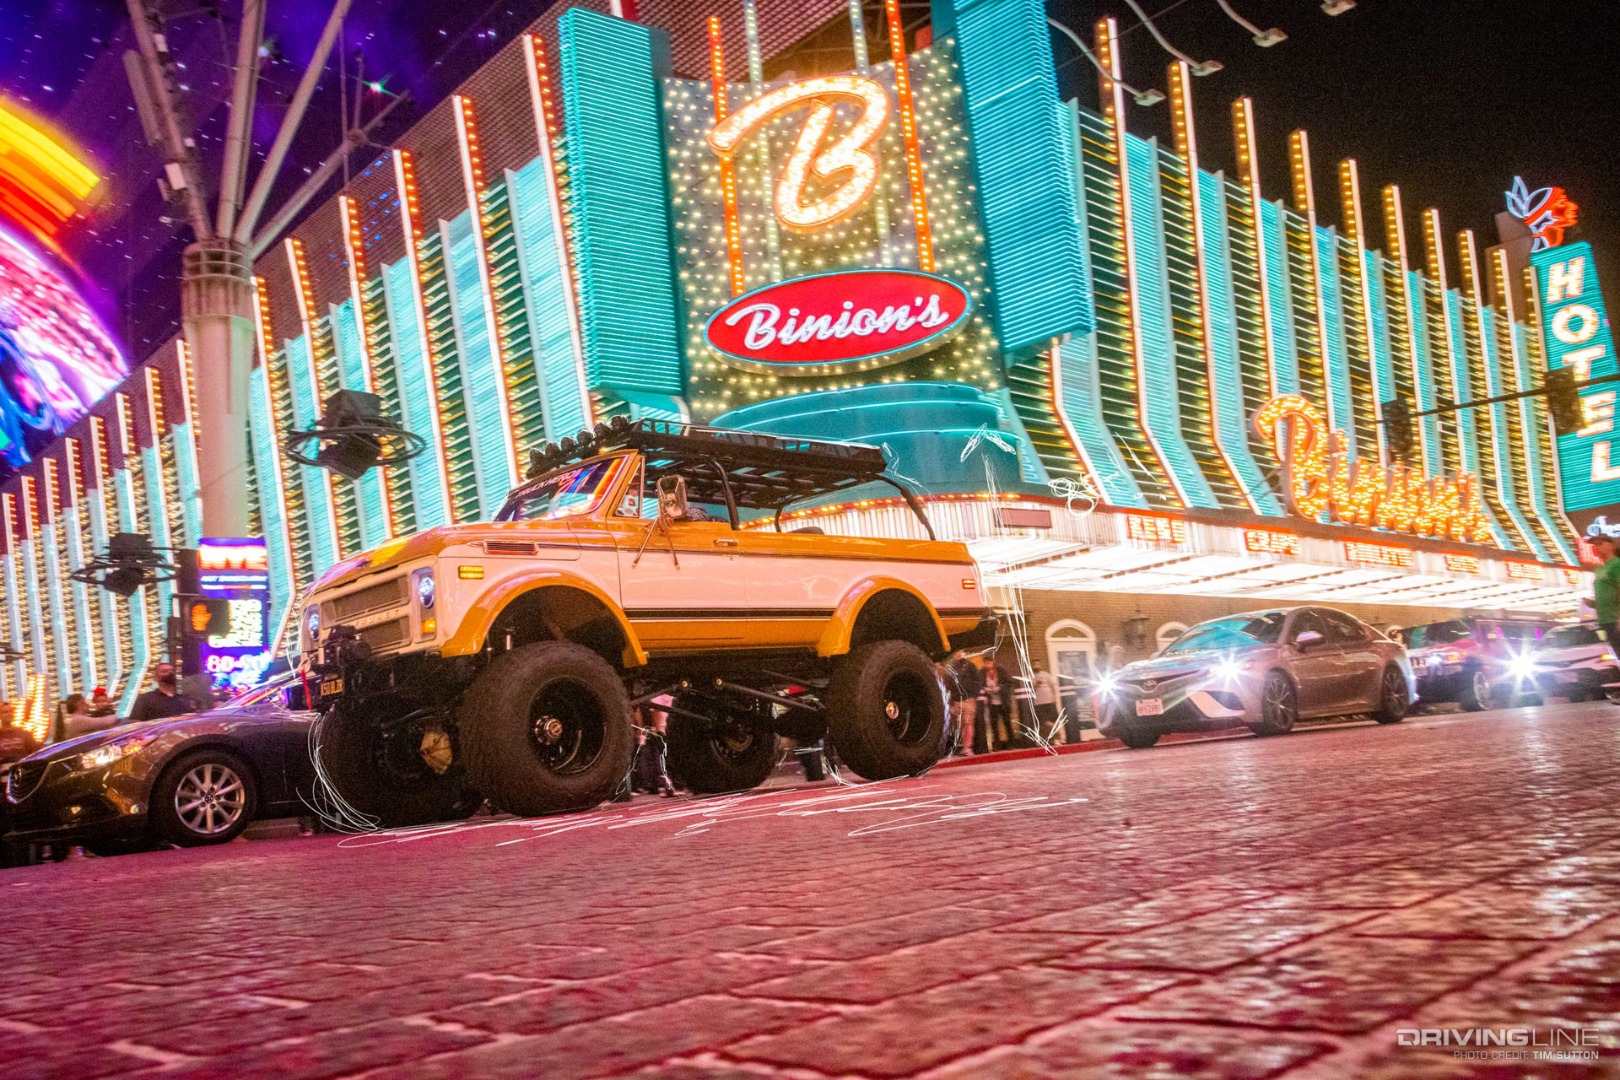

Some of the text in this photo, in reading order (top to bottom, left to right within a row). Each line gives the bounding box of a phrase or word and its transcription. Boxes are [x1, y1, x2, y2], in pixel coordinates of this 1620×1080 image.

[706, 75, 891, 232] B
[725, 294, 949, 350] Binion's
[1546, 255, 1620, 483] HOTEL
